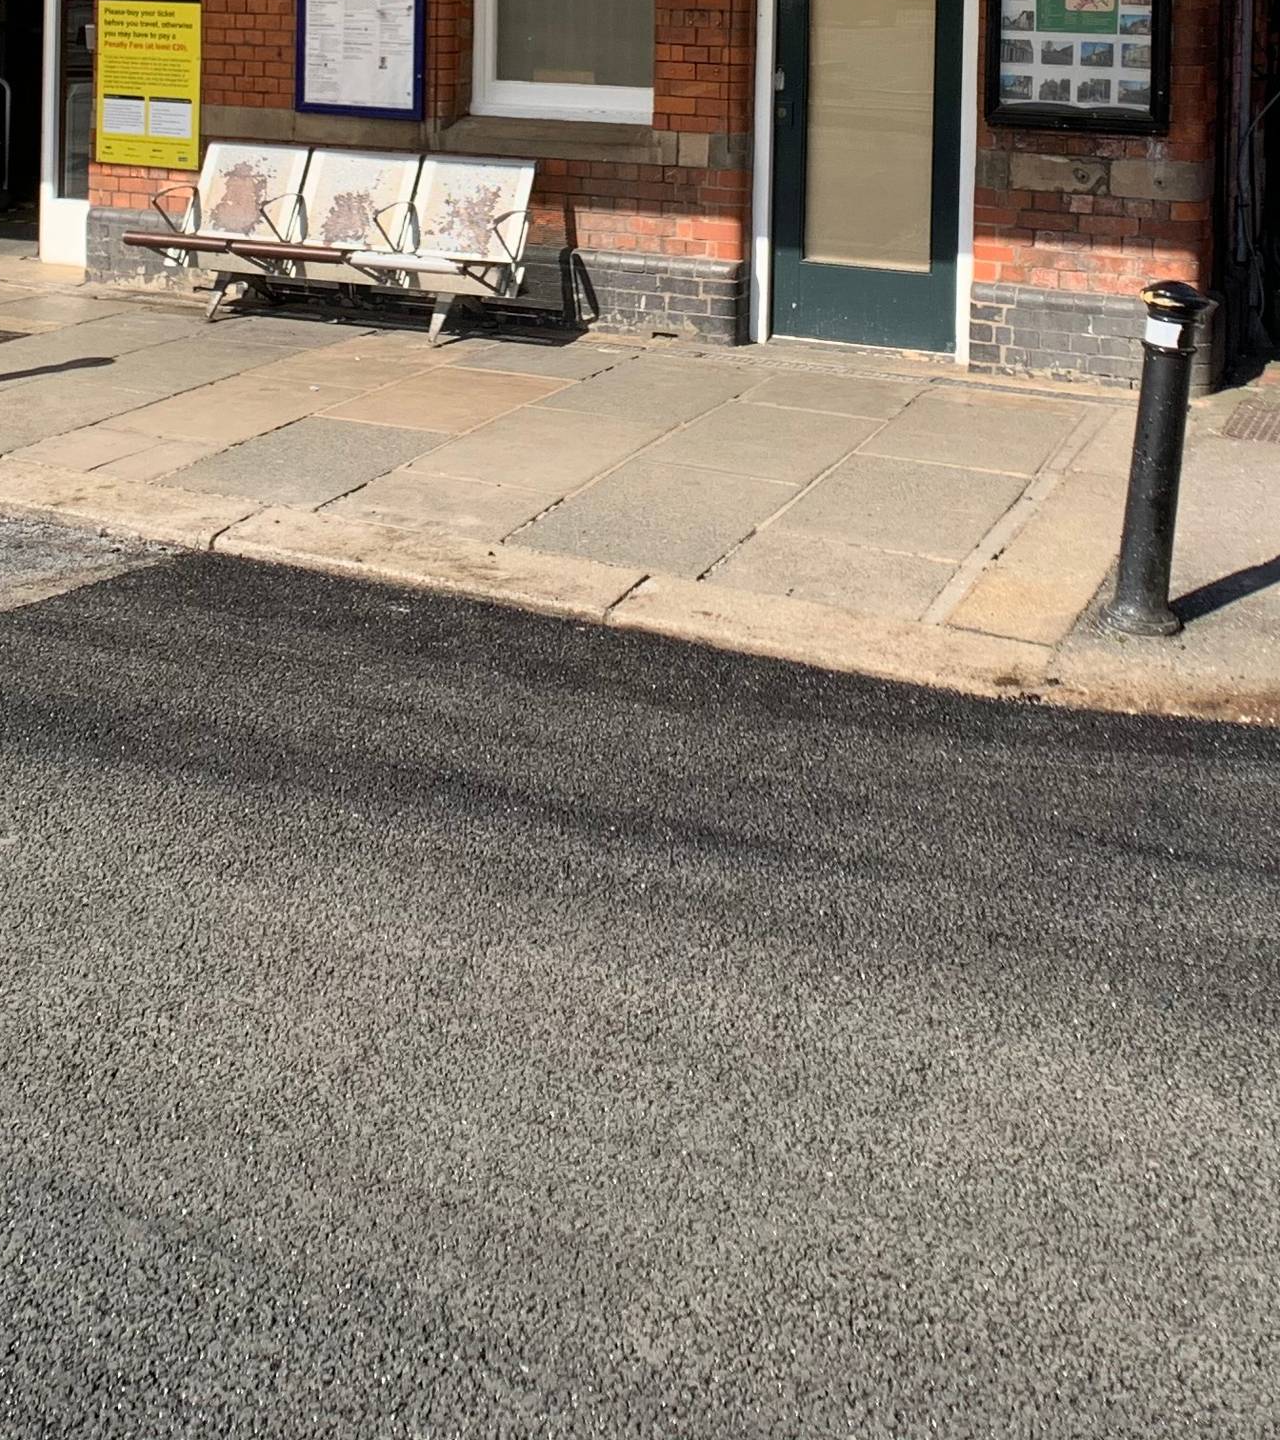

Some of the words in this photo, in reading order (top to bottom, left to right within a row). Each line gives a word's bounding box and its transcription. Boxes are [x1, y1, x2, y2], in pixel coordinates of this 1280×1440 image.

[104, 8, 125, 16] Please
[126, 9, 139, 17] buy
[141, 10, 155, 18] your
[104, 19, 124, 27] before
[126, 20, 139, 28] you
[161, 21, 193, 29] otherwise
[118, 31, 131, 39] may
[158, 33, 170, 41] pay
